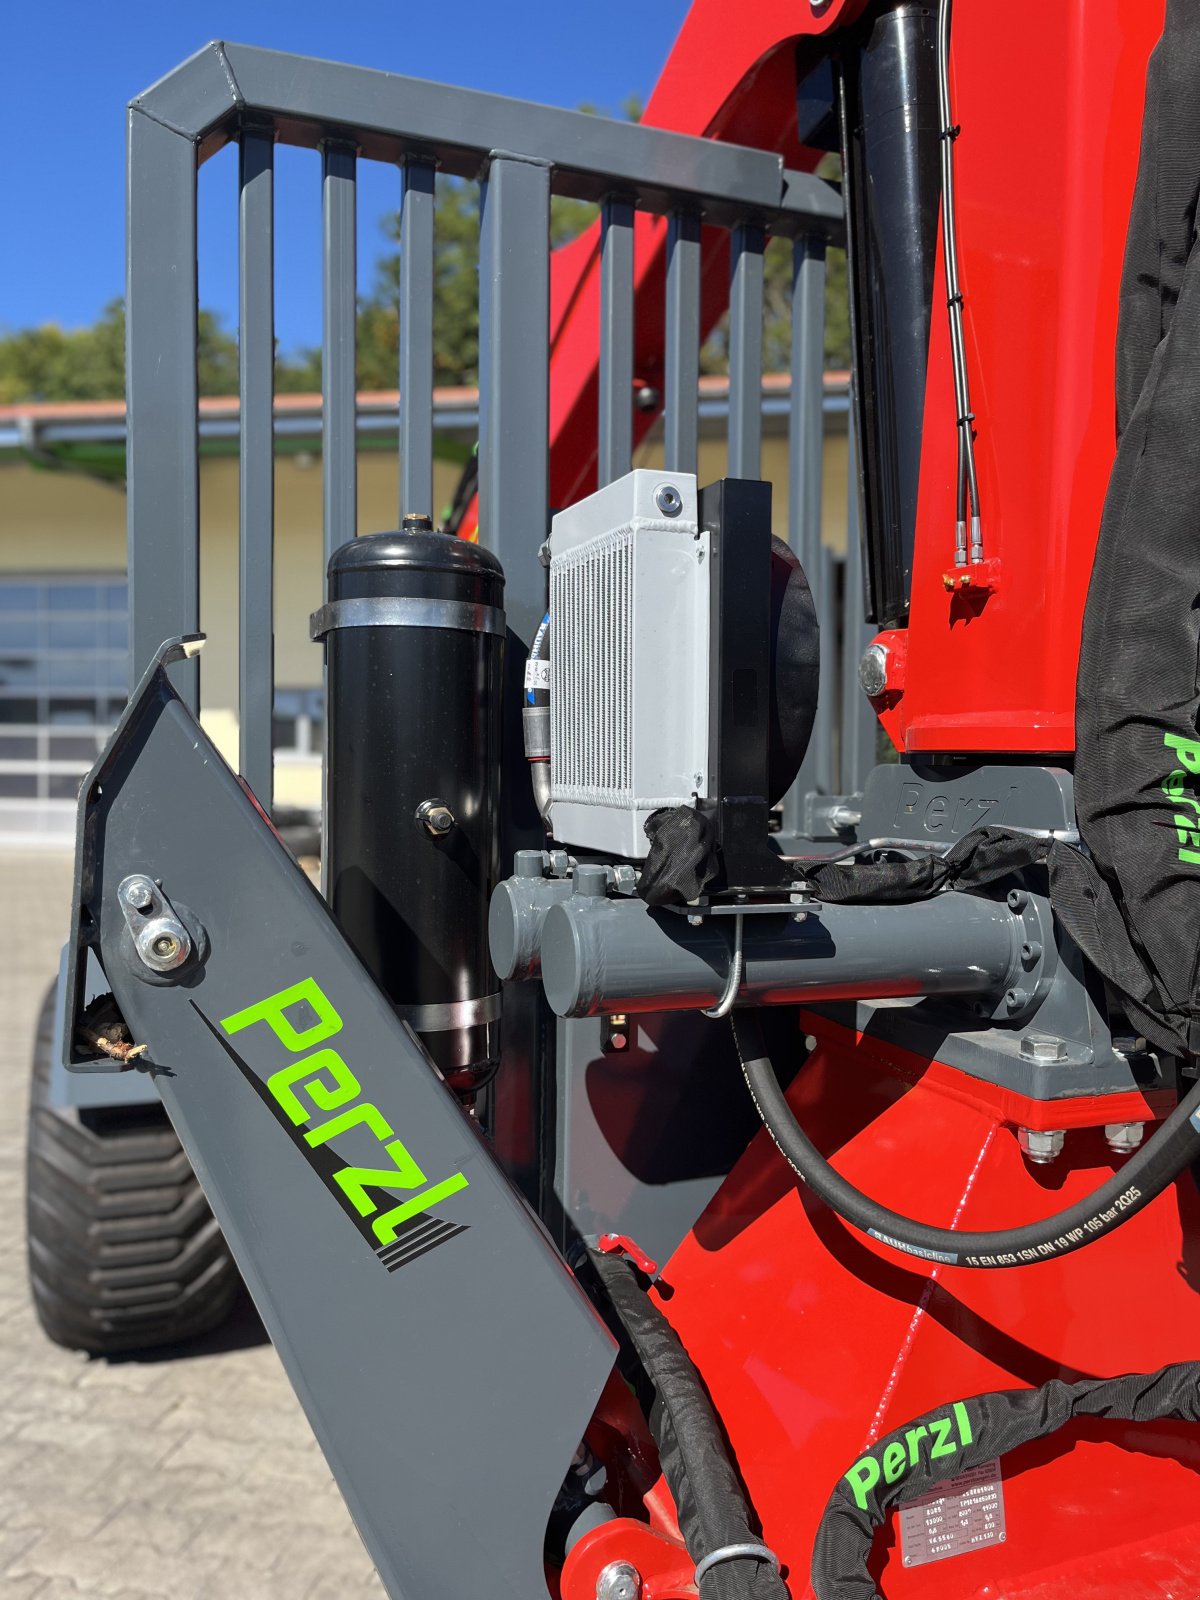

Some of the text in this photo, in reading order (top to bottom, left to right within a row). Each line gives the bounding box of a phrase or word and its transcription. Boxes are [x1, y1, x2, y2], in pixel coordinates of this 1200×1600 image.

[219, 976, 470, 1246] Perzl
[966, 1256, 980, 1266] 15
[979, 1255, 997, 1266] EN
[997, 1253, 1018, 1265] 853
[1017, 1247, 1039, 1261] 1SN
[1037, 1242, 1056, 1255] DN
[1054, 1237, 1069, 1249] 19
[1065, 1227, 1084, 1243] WP
[1083, 1217, 1103, 1233] 105
[1099, 1206, 1118, 1223] bar
[844, 1401, 973, 1510] Perzl
